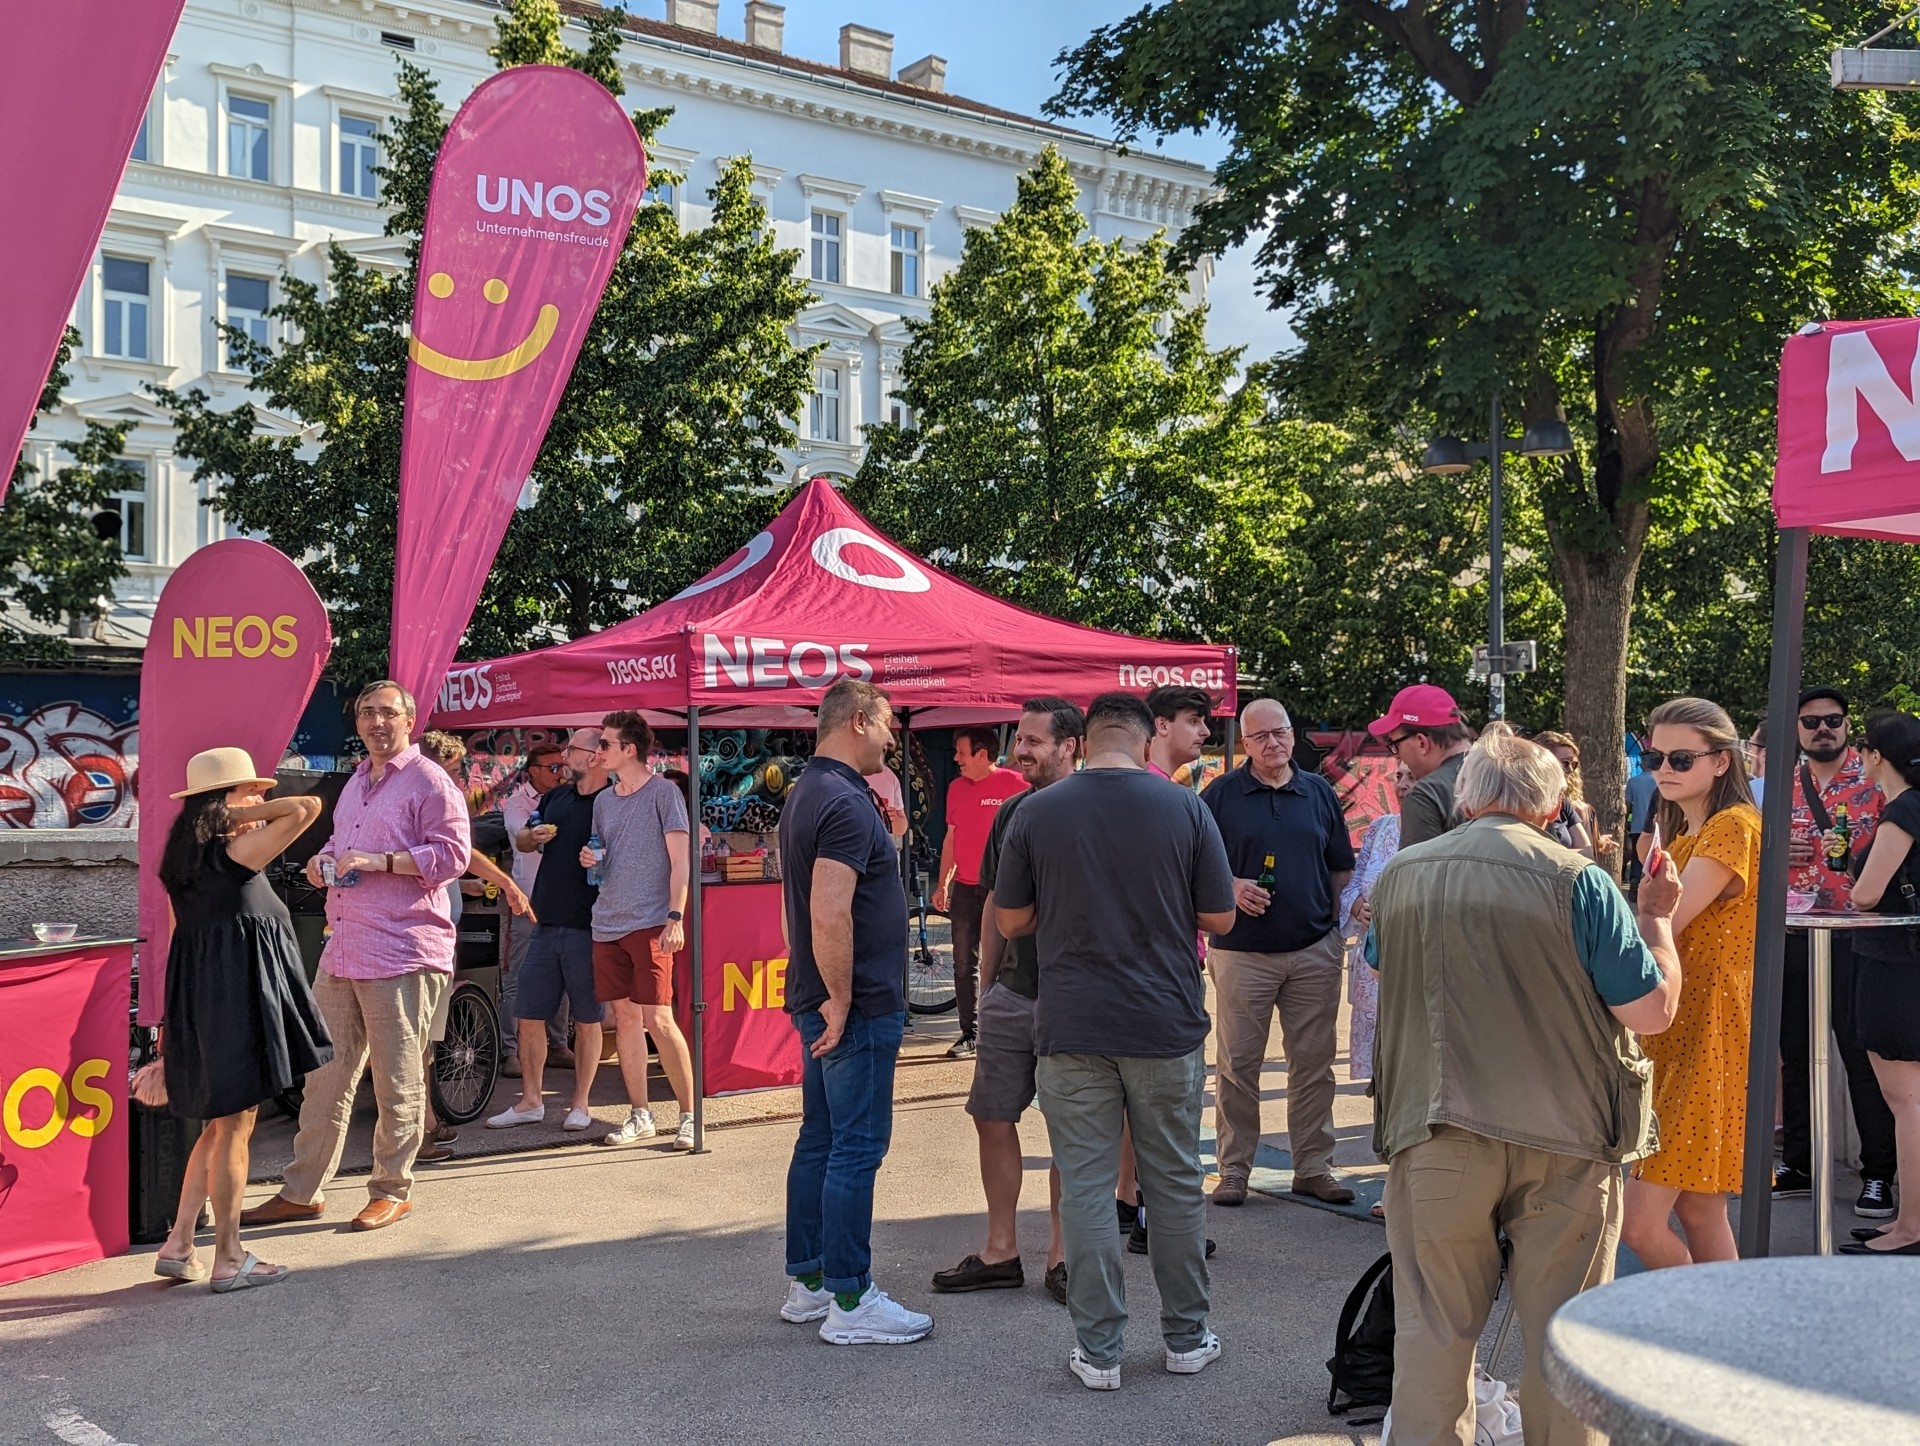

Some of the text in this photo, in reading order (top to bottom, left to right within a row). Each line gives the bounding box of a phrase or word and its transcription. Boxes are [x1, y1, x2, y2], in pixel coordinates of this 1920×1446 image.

[476, 174, 611, 226] UNOS
[476, 219, 609, 247] Unternehmensfreude
[173, 615, 298, 658] NEOS
[607, 653, 677, 685] neos.eu
[704, 633, 873, 690] NEOS
[883, 654, 919, 664] Freiheit
[885, 664, 933, 675] Fortschritt
[494, 671, 511, 682] Freiheit
[882, 676, 946, 688] Gerechtigkeit
[1118, 663, 1223, 690] neos.eu
[1403, 714, 1419, 722] NEOS
[980, 798, 1003, 806] NEOS
[723, 958, 789, 1012] NE
[0, 1058, 113, 1149] OS
